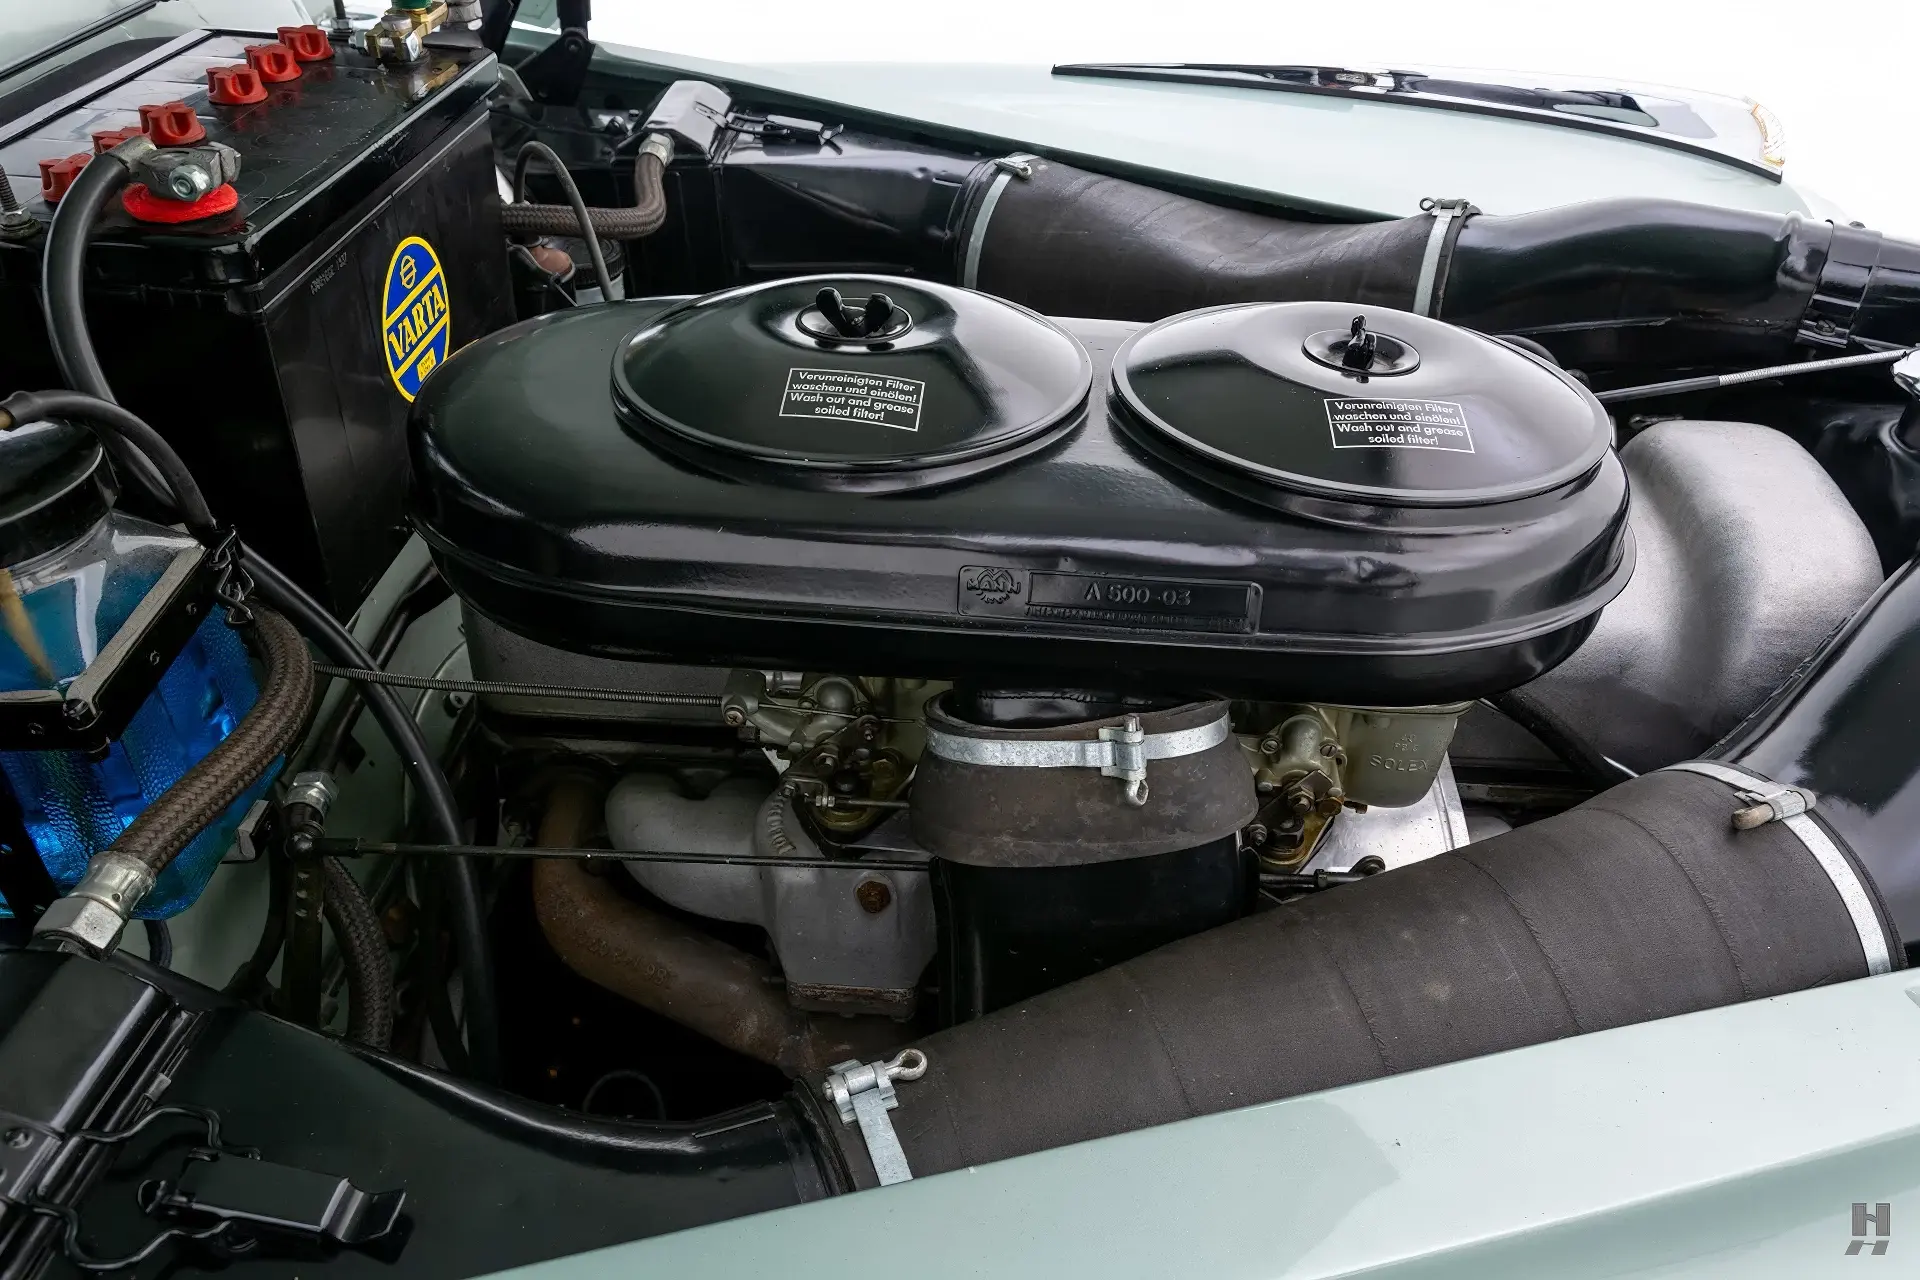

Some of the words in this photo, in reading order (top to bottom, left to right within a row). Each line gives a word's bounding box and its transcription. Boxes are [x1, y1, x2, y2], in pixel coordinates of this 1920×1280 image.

[389, 283, 446, 360] VARTA
[799, 371, 883, 386] Verunreinigten
[886, 379, 916, 392] Filter
[792, 383, 843, 393] waschen
[845, 386, 868, 395] und
[870, 388, 917, 403] einölen!
[790, 392, 824, 402] Wash
[826, 396, 845, 405] out
[848, 397, 871, 407] and
[874, 401, 914, 414] grease
[1334, 401, 1422, 411] Verunreinigten
[1424, 403, 1454, 414] Filter
[815, 405, 850, 416] soiled
[853, 407, 884, 420] filter!
[1333, 411, 1387, 421] waschen
[1389, 412, 1411, 421] und
[1336, 423, 1373, 432] Wash
[1375, 423, 1395, 432] out
[1397, 424, 1421, 433] and
[1424, 426, 1463, 437] grease
[1368, 434, 1405, 444] soiled
[1407, 434, 1439, 446] filter!
[1084, 582, 1100, 600] A
[1370, 754, 1429, 772] SOLEX
